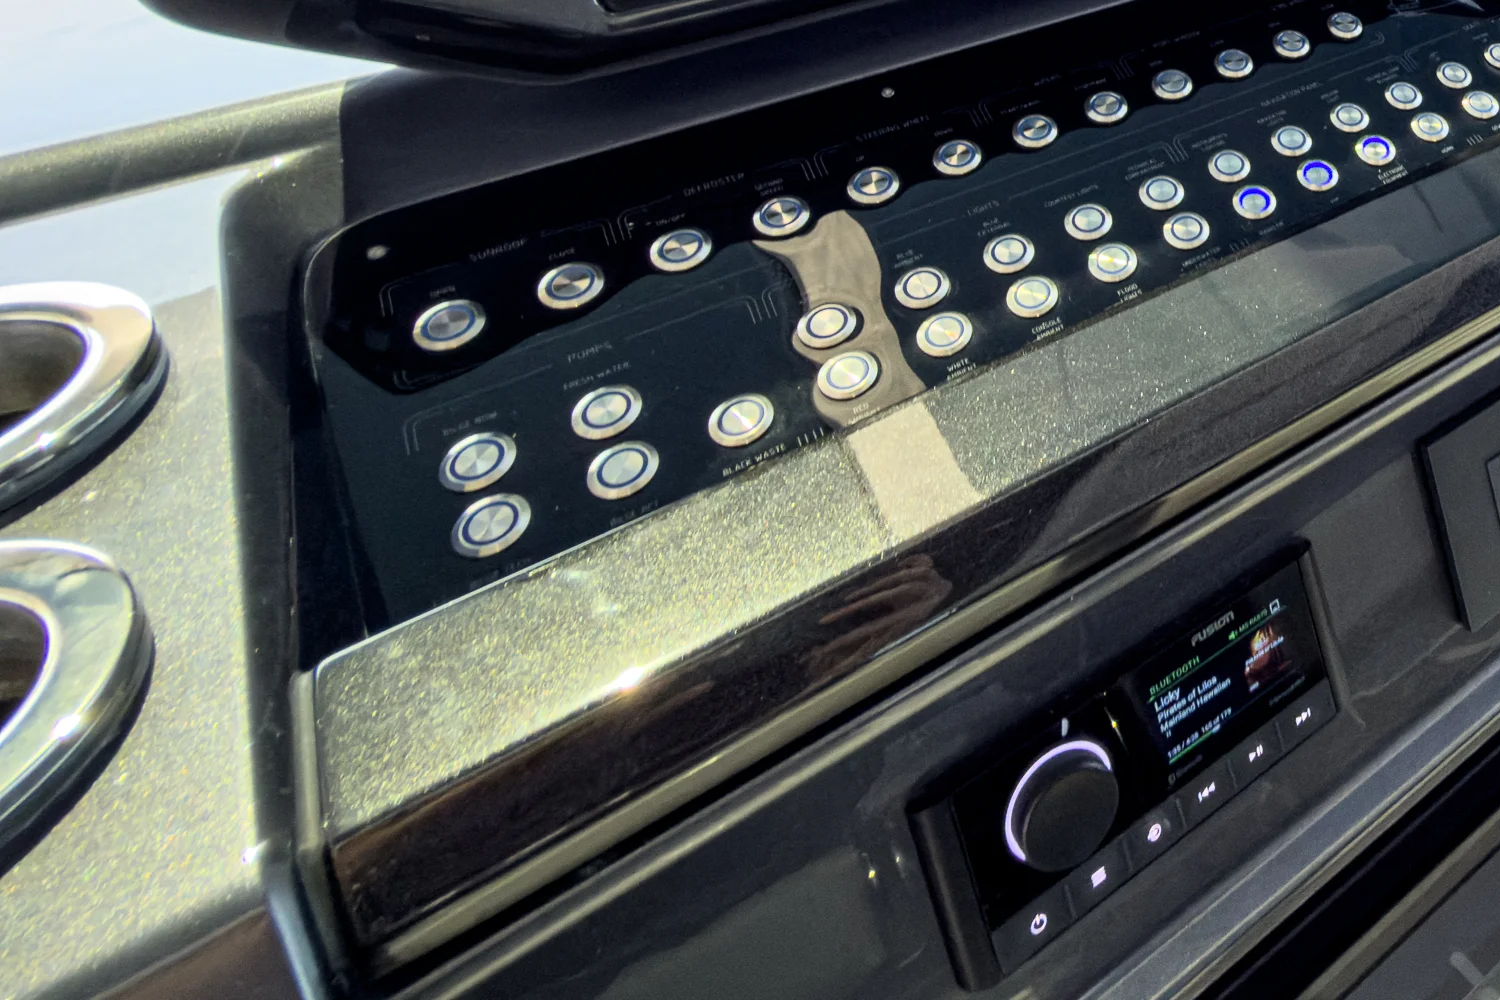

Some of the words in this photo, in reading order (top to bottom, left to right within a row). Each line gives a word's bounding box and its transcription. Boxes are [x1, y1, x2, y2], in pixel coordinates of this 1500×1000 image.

[468, 238, 529, 263] SUNROOF
[946, 357, 970, 373] WHITE
[852, 402, 870, 416] RED
[722, 458, 752, 478] BLACK
[753, 442, 787, 463] WASTE
[1149, 654, 1200, 696] BLUETOOTH
[1154, 687, 1180, 713] Licky
[1157, 697, 1187, 724] Pirates
[1187, 688, 1196, 702] of
[1160, 701, 1196, 735] Mainland
